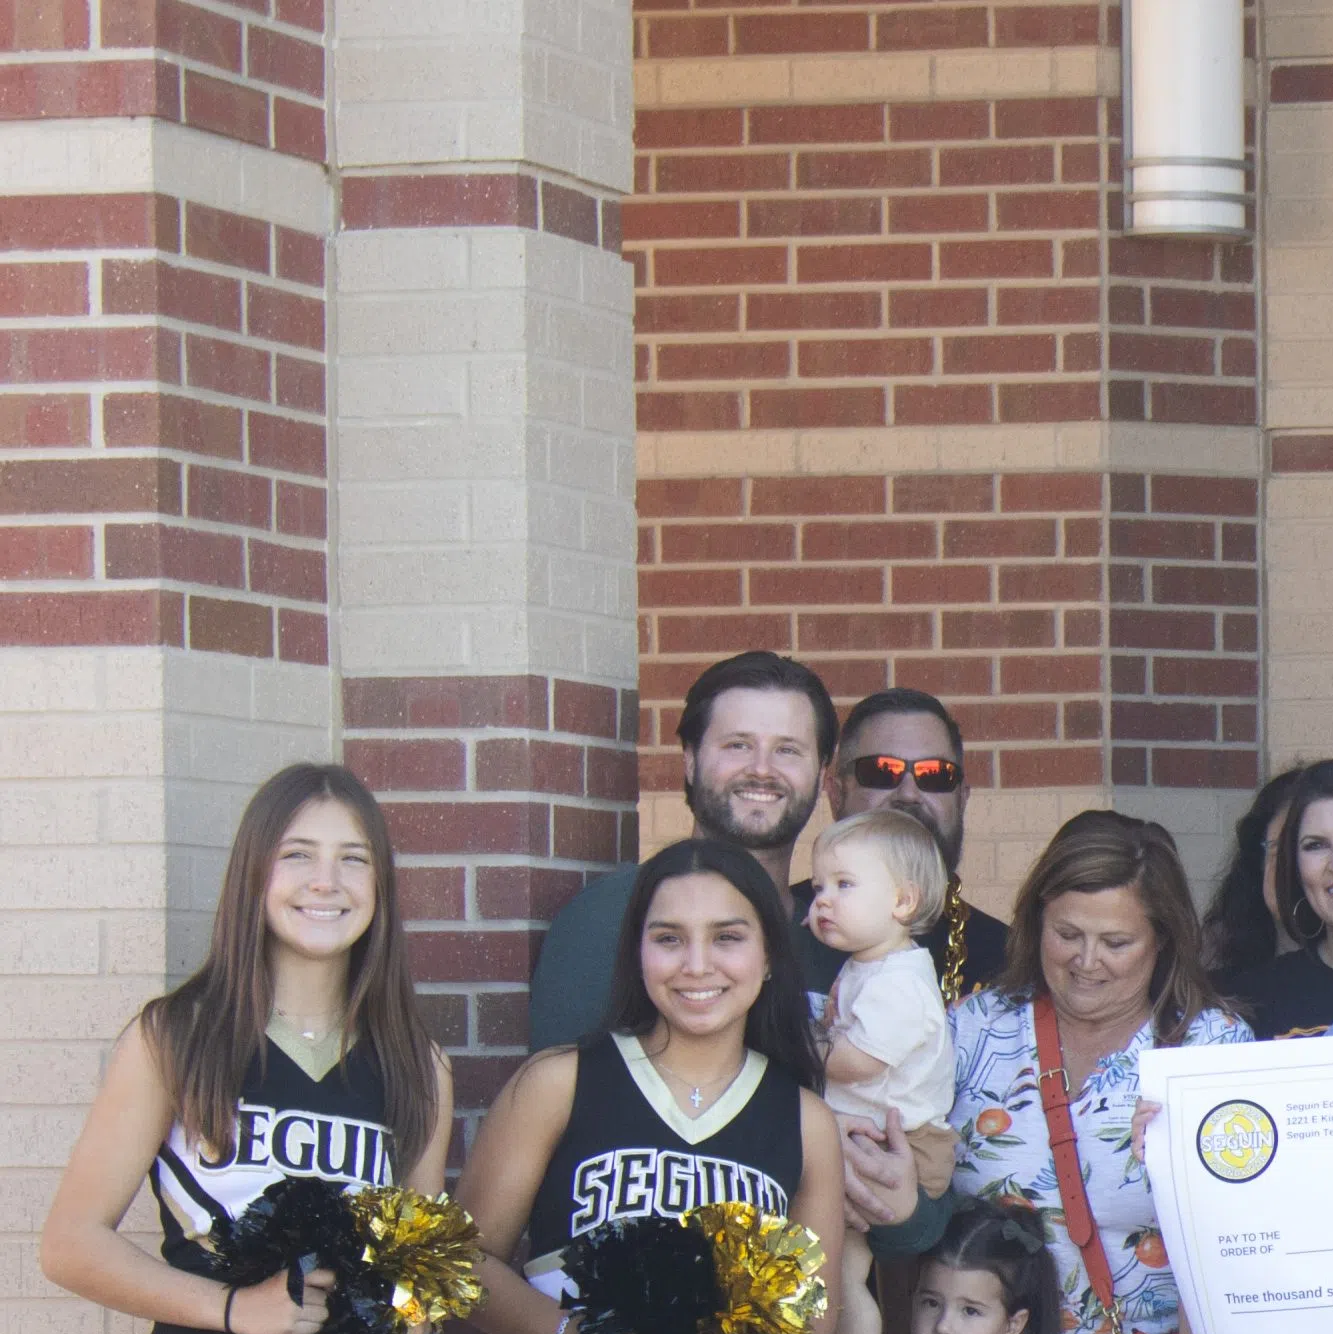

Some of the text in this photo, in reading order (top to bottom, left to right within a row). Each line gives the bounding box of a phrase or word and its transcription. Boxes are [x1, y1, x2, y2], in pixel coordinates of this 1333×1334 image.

[1286, 1102, 1319, 1112] Seguin
[1286, 1117, 1308, 1125] 1221
[1286, 1129, 1320, 1140] Seguin
[1201, 1131, 1273, 1153] SEGUIN
[1219, 1231, 1280, 1244] PAY TO THE
[1220, 1244, 1274, 1257] ORDER OF
[1224, 1293, 1259, 1304] Three
[1262, 1286, 1322, 1302] thousand
